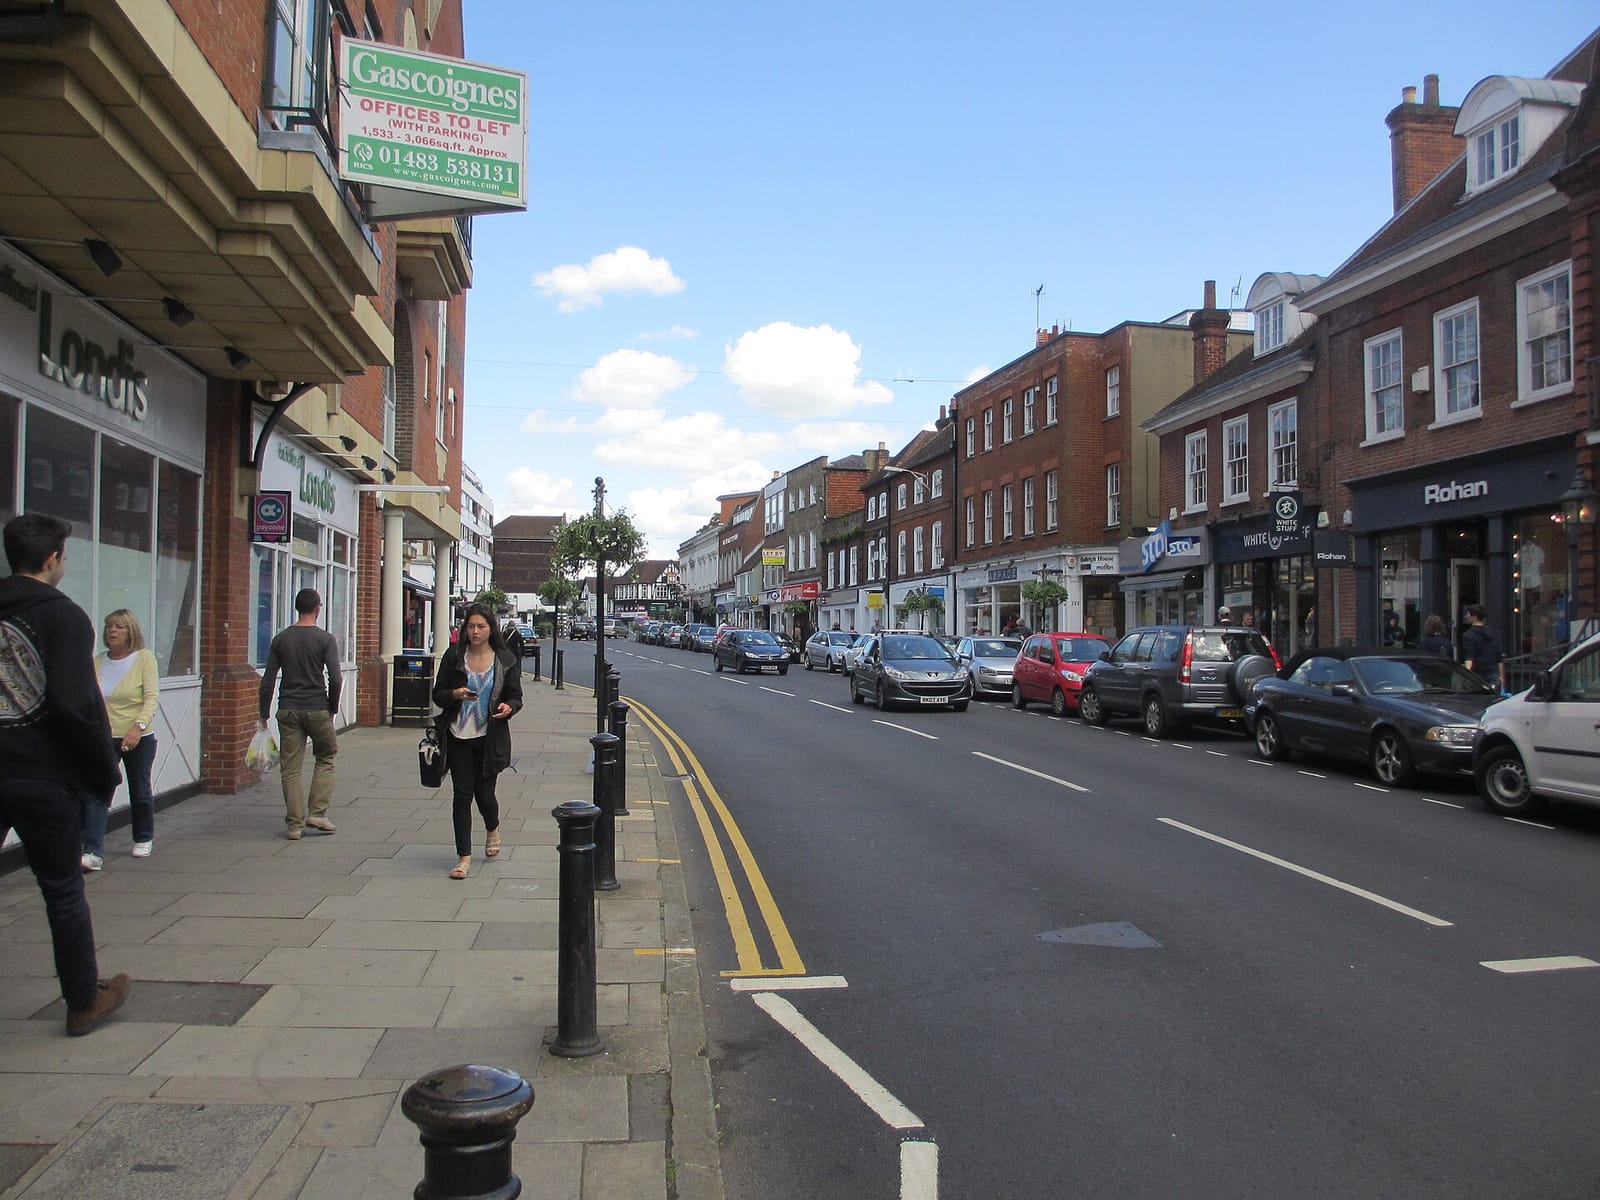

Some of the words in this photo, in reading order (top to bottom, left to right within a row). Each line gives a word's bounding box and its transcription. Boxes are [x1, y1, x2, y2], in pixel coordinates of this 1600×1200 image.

[352, 52, 517, 112] Gascoignes
[360, 98, 440, 124] OFFICES
[447, 113, 471, 129] TO
[477, 119, 510, 136] LET
[388, 119, 424, 132] (WITH
[427, 125, 484, 144] PARKING)
[361, 126, 393, 139] 1,533
[468, 145, 508, 159] Approx
[353, 162, 373, 171] RICS
[379, 146, 439, 171] 01483
[446, 158, 514, 184] 538131
[393, 167, 500, 190] www.gascoignes.com
[39, 289, 149, 421] Londis
[299, 454, 336, 514] Londis
[1425, 480, 1487, 505] Rohan
[1243, 532, 1267, 547] WHITE
[1317, 552, 1346, 560] Rohan
